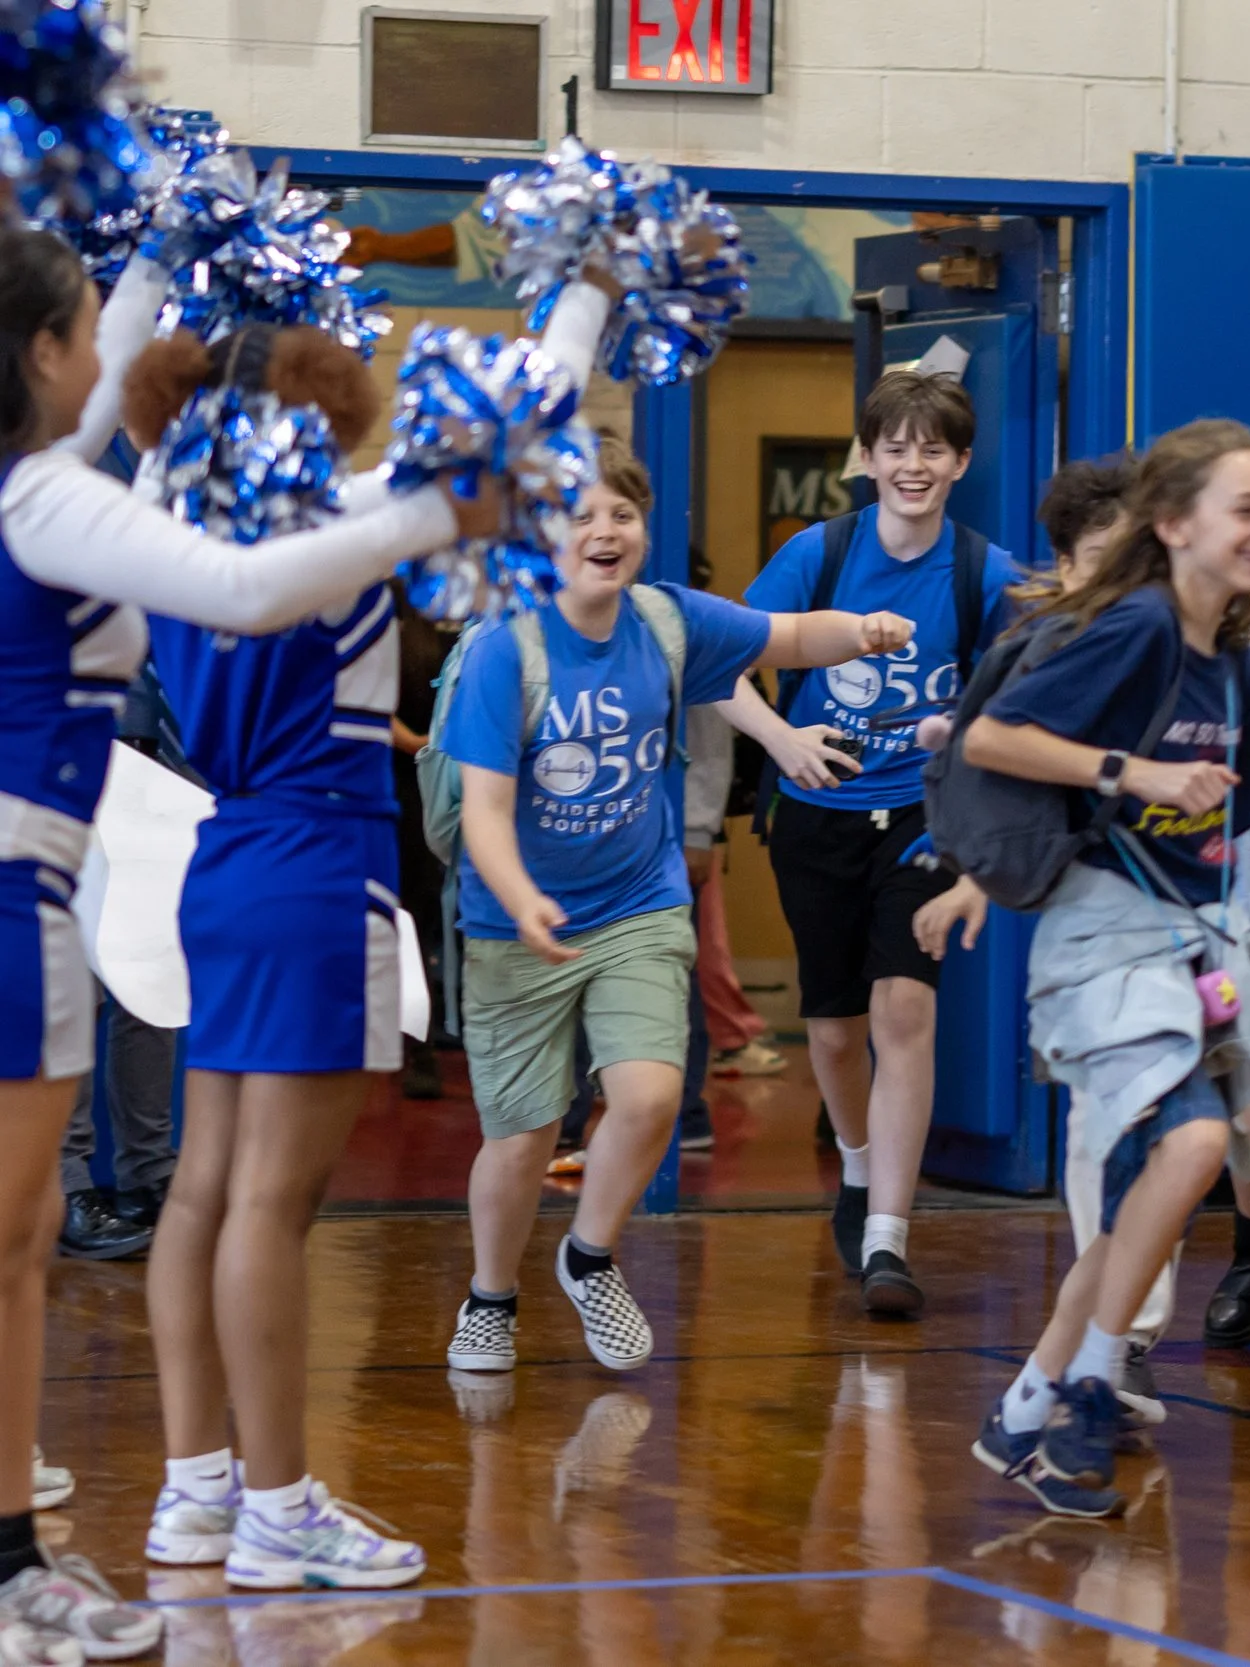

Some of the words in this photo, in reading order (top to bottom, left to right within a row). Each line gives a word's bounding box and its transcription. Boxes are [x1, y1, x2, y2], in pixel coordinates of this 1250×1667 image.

[769, 468, 852, 518] MS
[539, 686, 629, 740] MS
[823, 699, 870, 730] PRID
[593, 727, 665, 797] 50
[532, 795, 600, 817] PRIDE
[604, 799, 632, 815] OF
